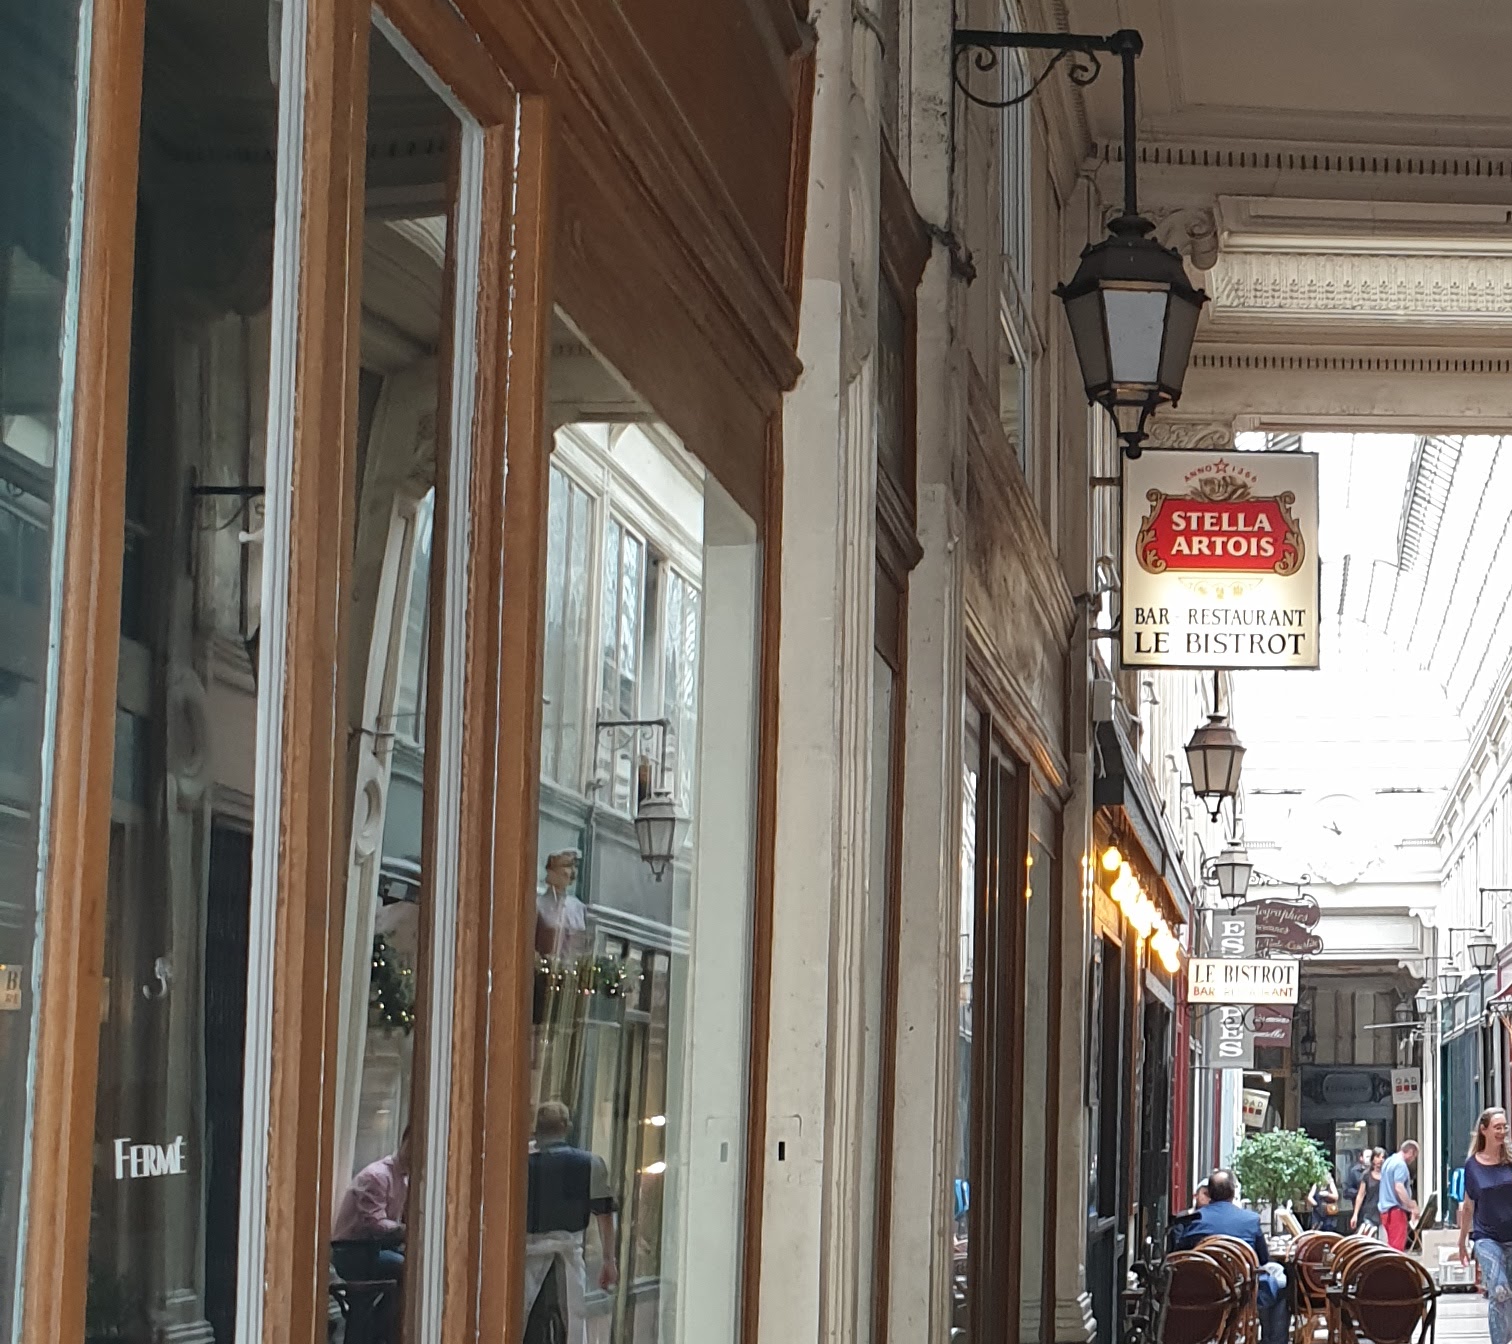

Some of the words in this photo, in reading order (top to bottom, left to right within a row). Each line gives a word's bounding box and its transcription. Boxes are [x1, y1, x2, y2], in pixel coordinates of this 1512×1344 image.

[1184, 464, 1212, 483] ANNO
[1231, 465, 1257, 483] 1366
[1171, 511, 1272, 532] STELLA
[1170, 535, 1275, 556] ARTOIS
[1134, 607, 1170, 625] BAR
[1188, 608, 1306, 627] RESTAURANT
[1134, 632, 1170, 654] LE
[1186, 632, 1306, 655] BISTROT
[1194, 964, 1216, 984] LE
[1224, 964, 1295, 985] BISTROT
[1193, 986, 1216, 997] BAR
